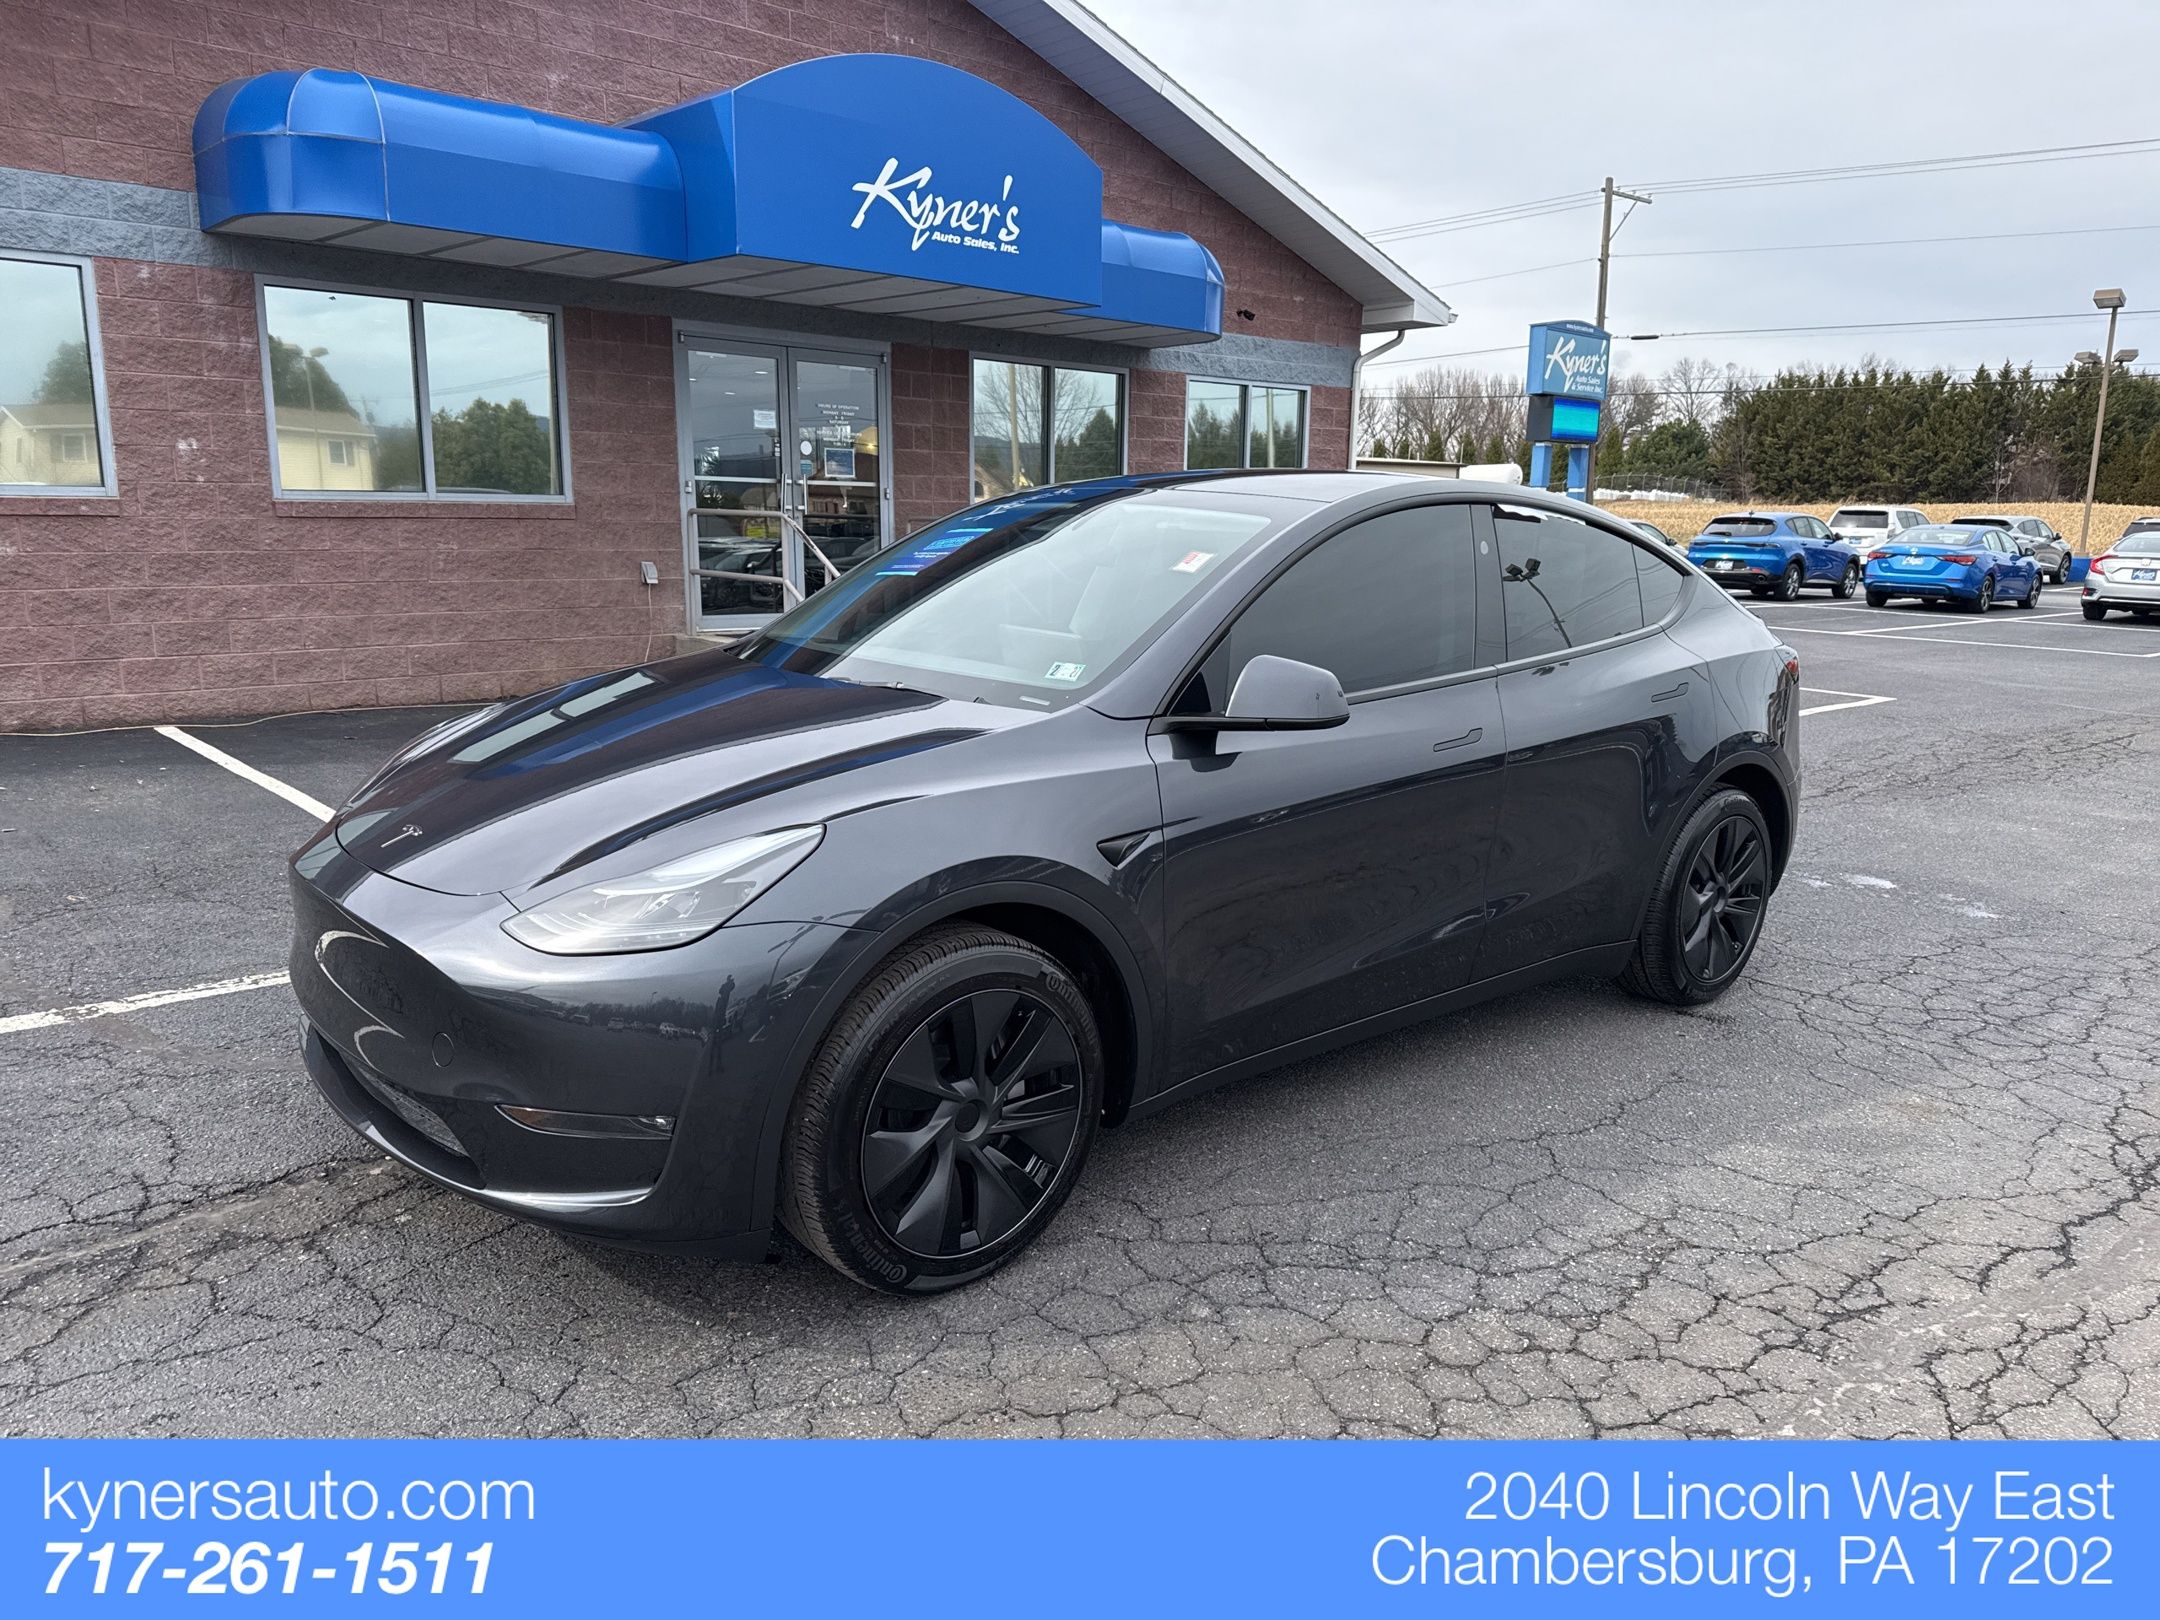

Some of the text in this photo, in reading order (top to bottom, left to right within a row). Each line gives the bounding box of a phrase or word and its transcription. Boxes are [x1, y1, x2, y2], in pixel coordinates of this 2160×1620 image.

[850, 157, 1021, 251] Kyner's
[931, 231, 1020, 254] Auto Sales, Inc.
[1544, 336, 1607, 393] Kyner's
[1576, 375, 1600, 385] Auto Sales
